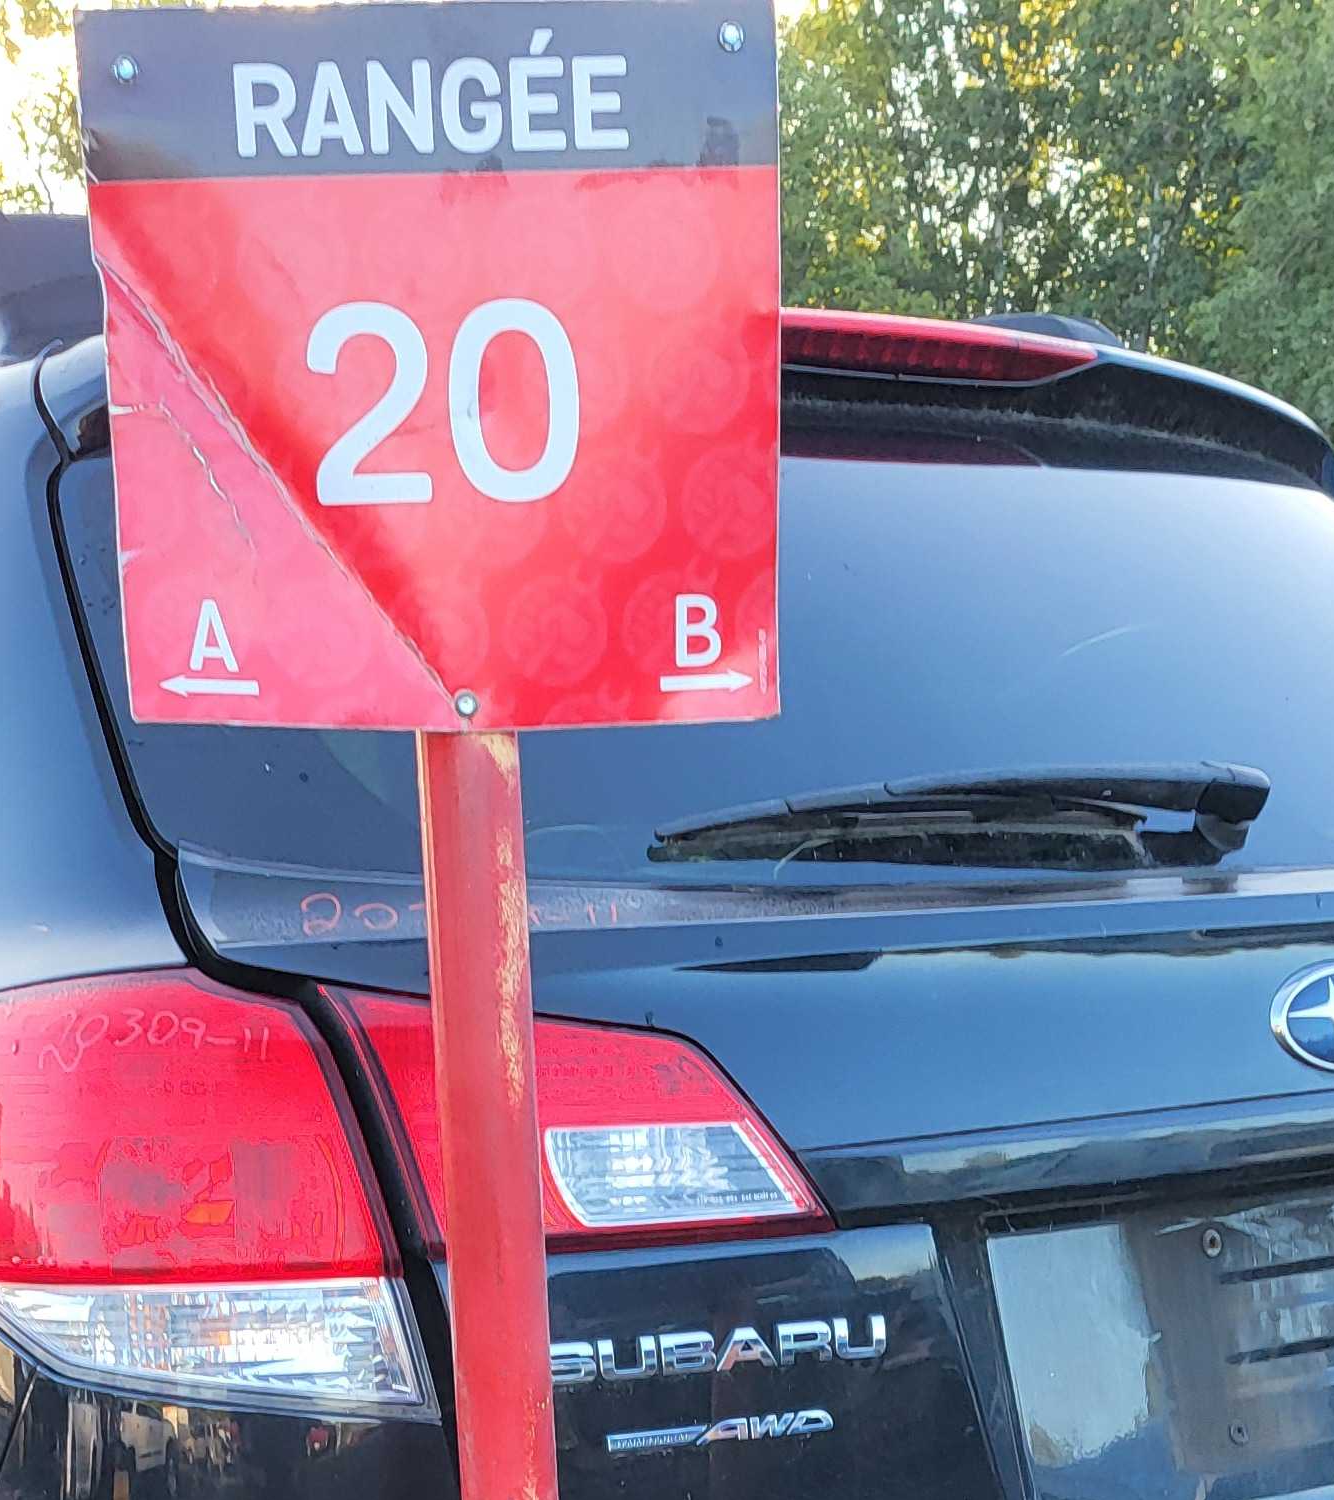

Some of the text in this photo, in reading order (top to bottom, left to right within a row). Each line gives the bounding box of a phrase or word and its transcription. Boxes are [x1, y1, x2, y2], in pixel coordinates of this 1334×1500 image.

[231, 28, 630, 158] RANGÉE
[306, 298, 580, 506] 20
[189, 598, 240, 674] A
[674, 594, 723, 669] B
[550, 1314, 887, 1384] SUBARU
[696, 1408, 835, 1446] AWD
